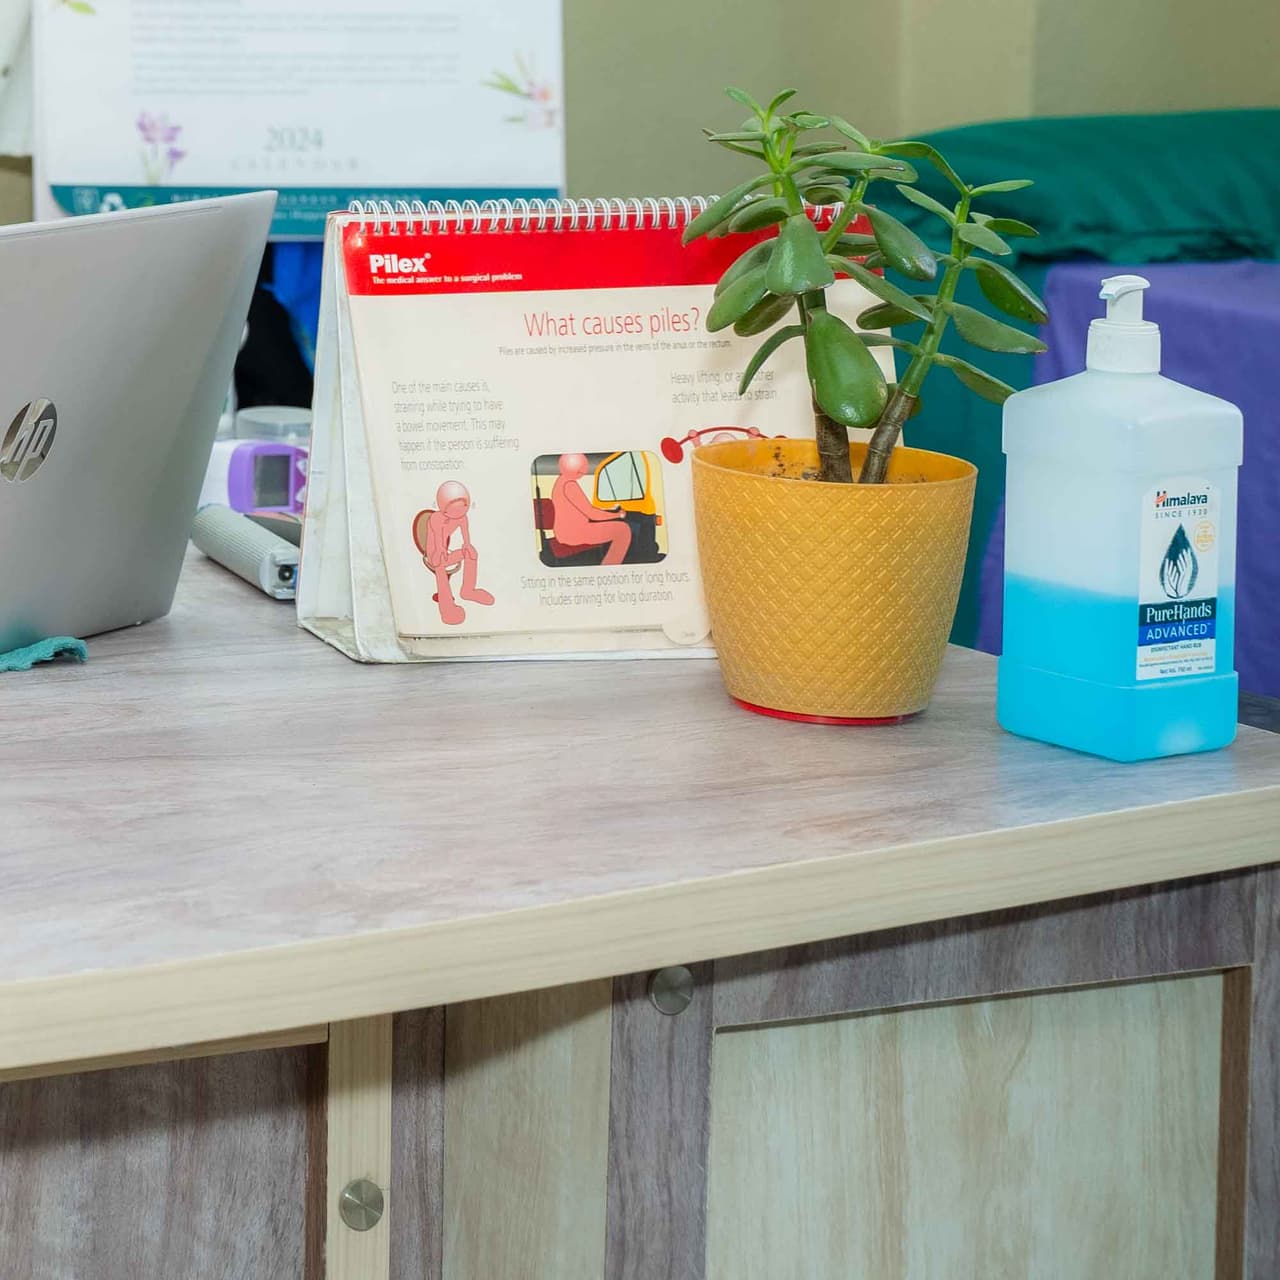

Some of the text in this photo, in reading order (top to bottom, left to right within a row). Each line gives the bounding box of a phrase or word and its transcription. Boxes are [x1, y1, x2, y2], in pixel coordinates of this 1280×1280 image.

[263, 126, 324, 153] 2024
[372, 276, 385, 284] The
[386, 275, 414, 284] medical
[444, 275, 453, 283] to
[460, 273, 490, 284] surgical
[491, 272, 523, 283] problem
[524, 307, 701, 338] What causes piles?
[526, 344, 547, 355] caused
[558, 343, 587, 354] increased
[588, 344, 614, 356] pressure
[623, 342, 634, 352] the
[661, 340, 672, 350] the
[392, 380, 408, 393] One
[418, 380, 431, 393] the
[432, 380, 452, 392] main
[455, 380, 480, 393] causes
[671, 371, 694, 386] Heavy
[724, 371, 734, 382] or
[671, 390, 699, 406] activity
[702, 389, 718, 402] that
[426, 399, 447, 412] while
[449, 400, 471, 415] trying
[472, 400, 482, 411] to
[484, 398, 504, 411] have
[402, 419, 424, 433] bowel
[471, 417, 487, 431] This
[489, 419, 505, 434] may
[0, 398, 57, 483] hp
[434, 438, 446, 451] the
[448, 439, 474, 453] person
[483, 435, 520, 452] suffering
[1155, 490, 1208, 508] Himalaya
[1155, 510, 1182, 519] SINCE
[521, 576, 546, 591] Sitting
[548, 576, 556, 587] in
[558, 574, 572, 587] the
[573, 576, 595, 586] same
[597, 571, 630, 588] position
[631, 571, 643, 584] for
[645, 570, 664, 585] long
[539, 591, 572, 606] Includes
[575, 591, 601, 607] driving
[603, 590, 616, 604] for
[617, 589, 637, 606] long
[1146, 602, 1212, 623] PureHands
[1146, 623, 1208, 640] ADVANCED
